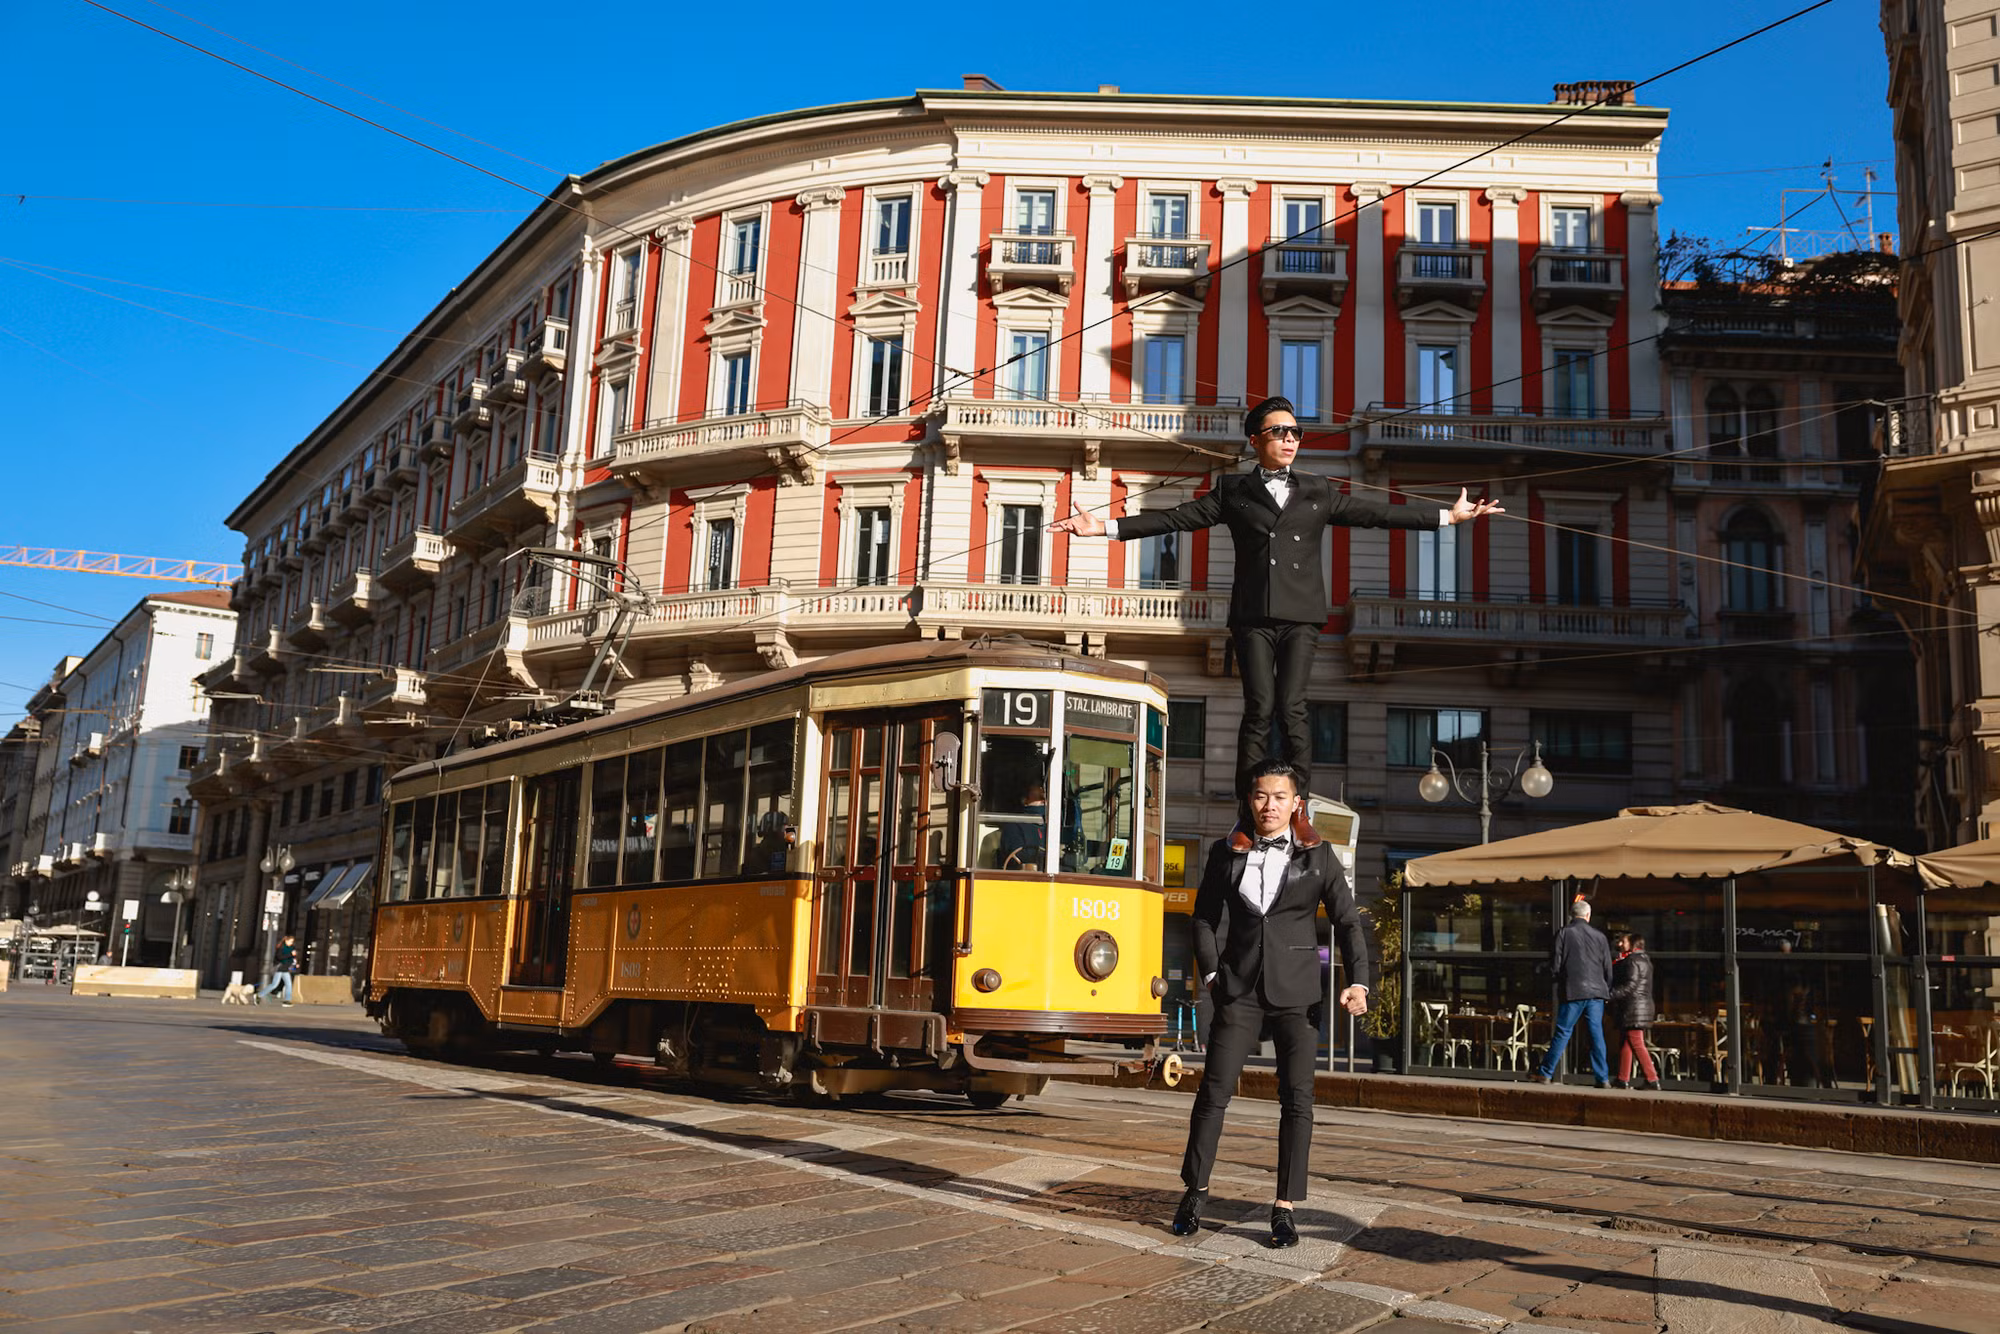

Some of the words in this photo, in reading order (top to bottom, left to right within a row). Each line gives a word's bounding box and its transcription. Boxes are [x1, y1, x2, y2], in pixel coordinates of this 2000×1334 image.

[1003, 692, 1038, 725] 19
[1112, 844, 1123, 856] 41
[1110, 858, 1121, 868] 19
[1072, 897, 1120, 920] 1803
[620, 961, 641, 979] 1803
